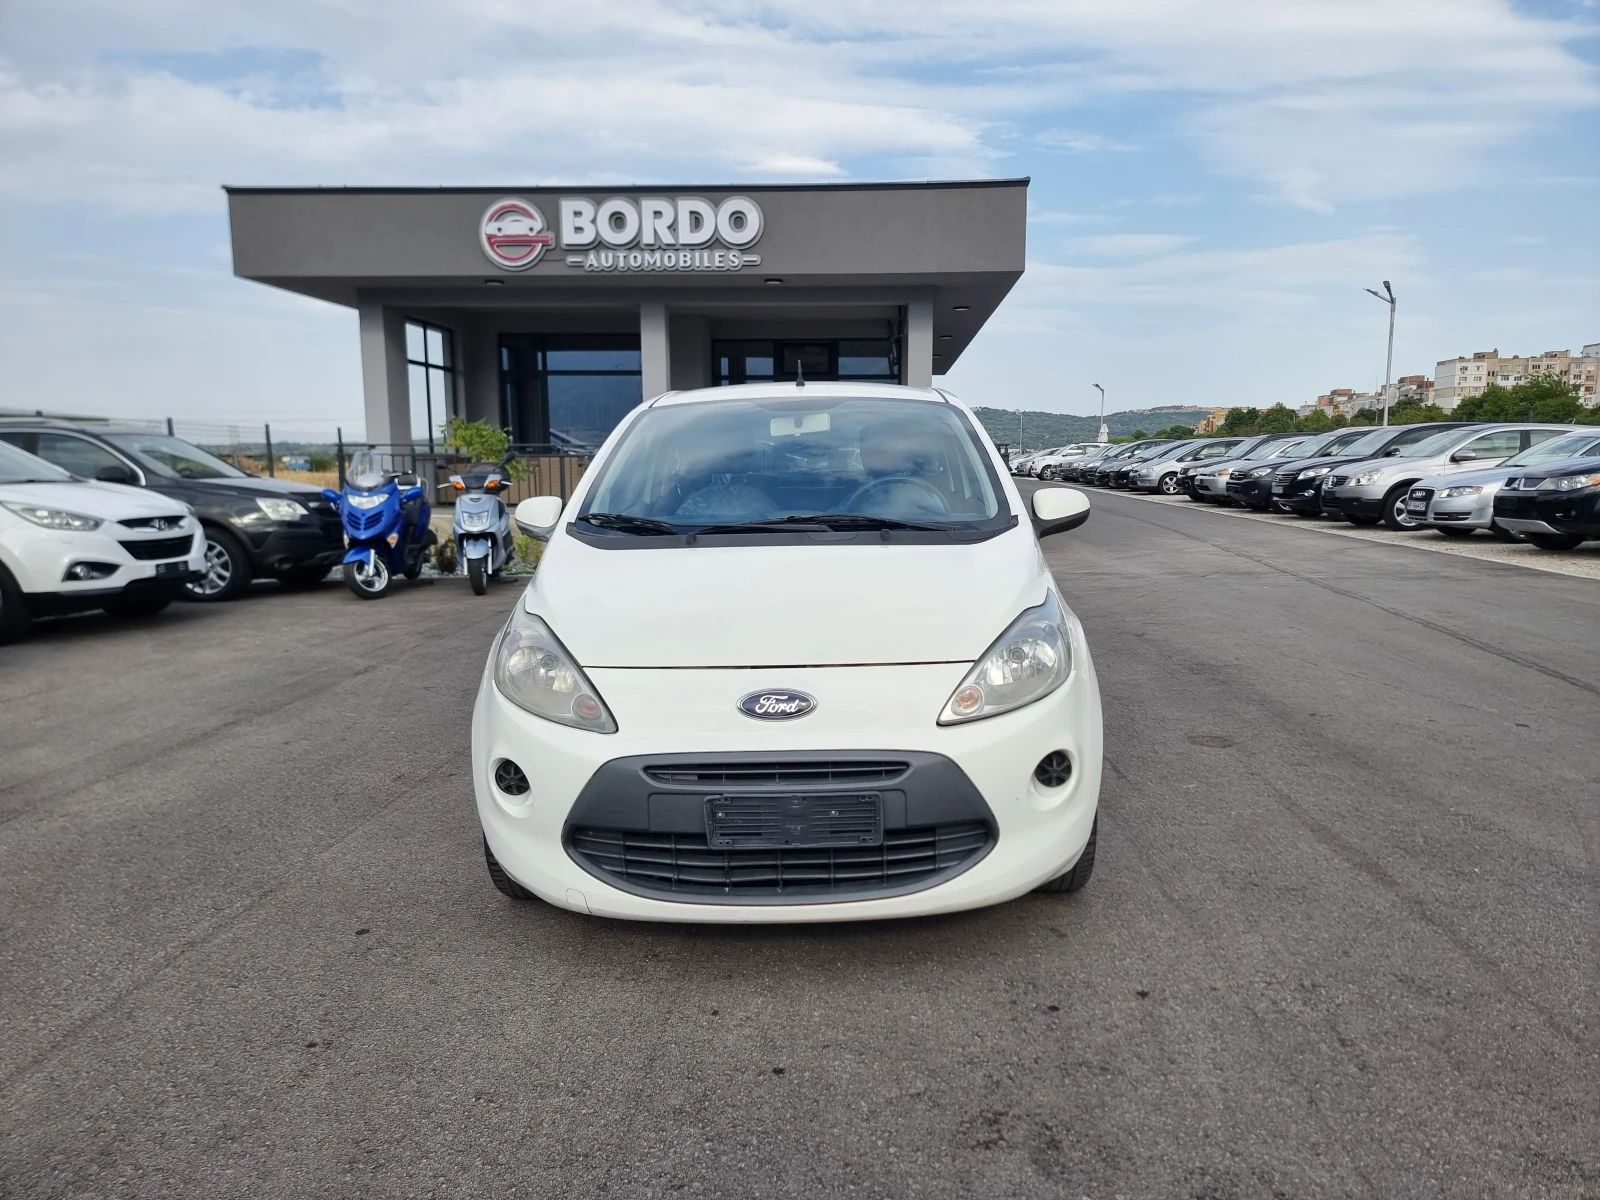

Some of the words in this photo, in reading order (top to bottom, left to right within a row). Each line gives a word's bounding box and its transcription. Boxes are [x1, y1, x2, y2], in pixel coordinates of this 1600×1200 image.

[561, 198, 762, 246] BORDO
[586, 251, 740, 268] AUTOMOBILES
[755, 694, 800, 714] Ford
